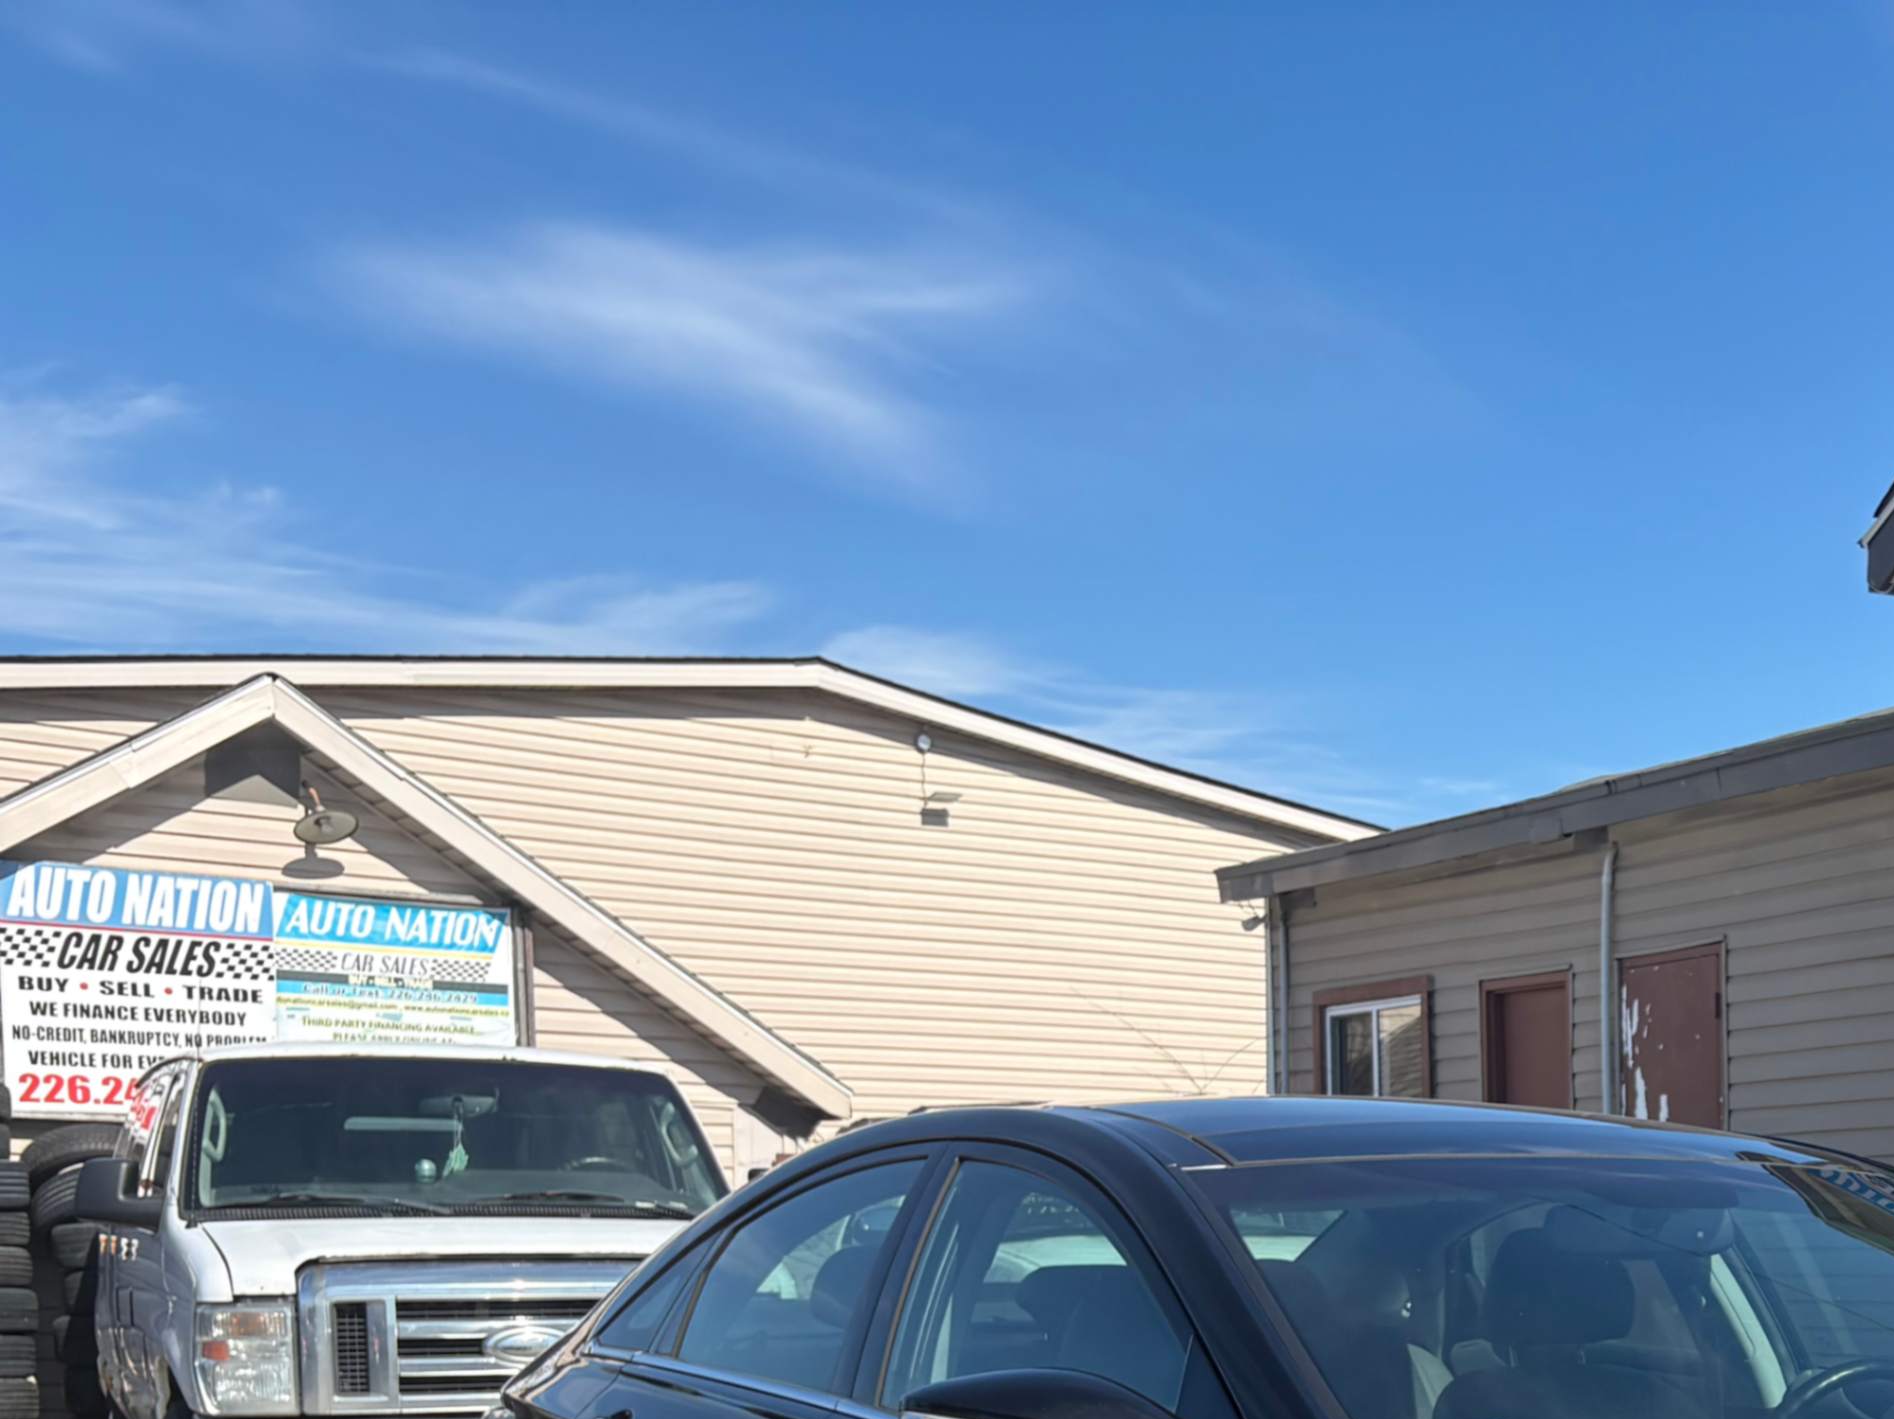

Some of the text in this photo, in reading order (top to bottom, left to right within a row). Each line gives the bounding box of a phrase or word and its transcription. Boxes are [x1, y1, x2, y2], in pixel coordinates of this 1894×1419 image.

[7, 864, 262, 935] AUTO NATION
[286, 898, 498, 948] AUTO NATION
[57, 931, 221, 978] CAR SALES
[340, 952, 430, 976] CAR SALES
[18, 974, 263, 1004] BUY SELL TRADE
[29, 1000, 247, 1027] WE FINANCE EVERYBODY
[334, 1018, 366, 1029] PARTY
[12, 1023, 87, 1045] NO-CREDIT,
[90, 1028, 183, 1049] BANKRUPTCY,
[185, 1032, 202, 1048] NO
[28, 1050, 97, 1068] VEHICLE
[101, 1053, 133, 1069] FOR
